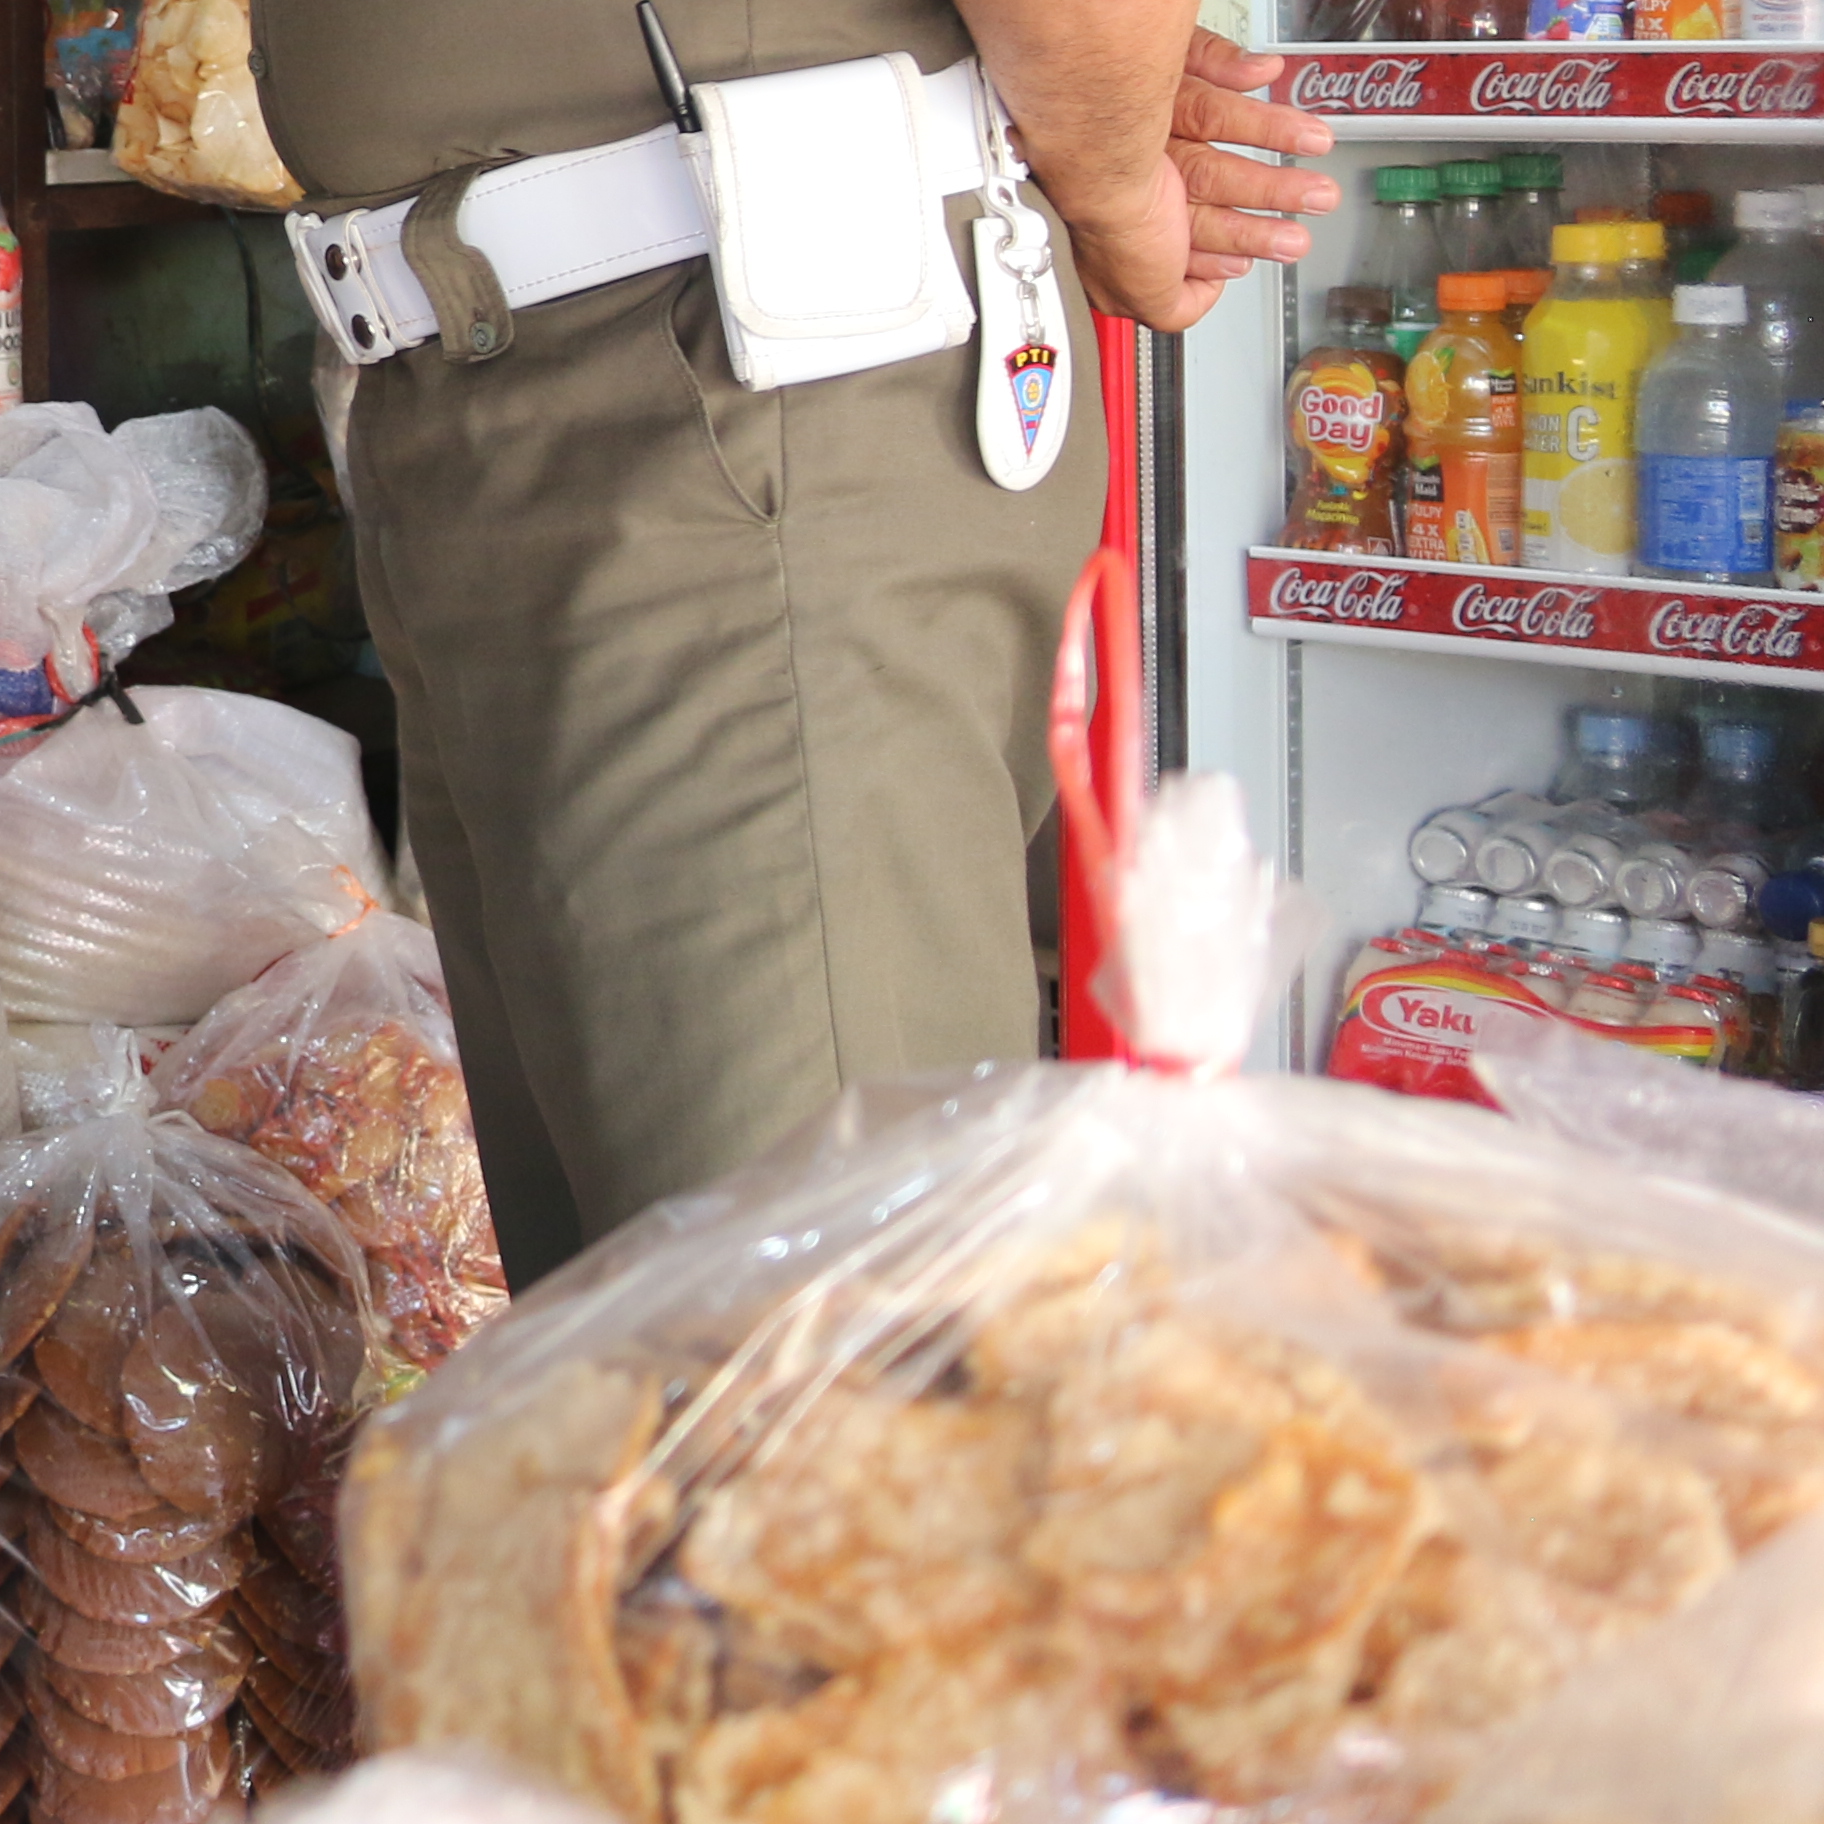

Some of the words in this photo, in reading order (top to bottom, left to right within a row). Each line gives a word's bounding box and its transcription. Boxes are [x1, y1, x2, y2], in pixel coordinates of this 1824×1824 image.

[1289, 58, 1428, 112] Coca-Cola
[1471, 58, 1620, 114] Coca-Cola
[1665, 58, 1818, 114] Coca-Cola
[1015, 349, 1052, 369] PTI
[1301, 390, 1382, 420] Good
[1308, 416, 1374, 451] Day
[1566, 405, 1600, 462] C
[1270, 567, 1407, 622] Coca-Cola
[1452, 582, 1599, 640] Coca-Cola
[1649, 599, 1808, 658] Coca-Cola
